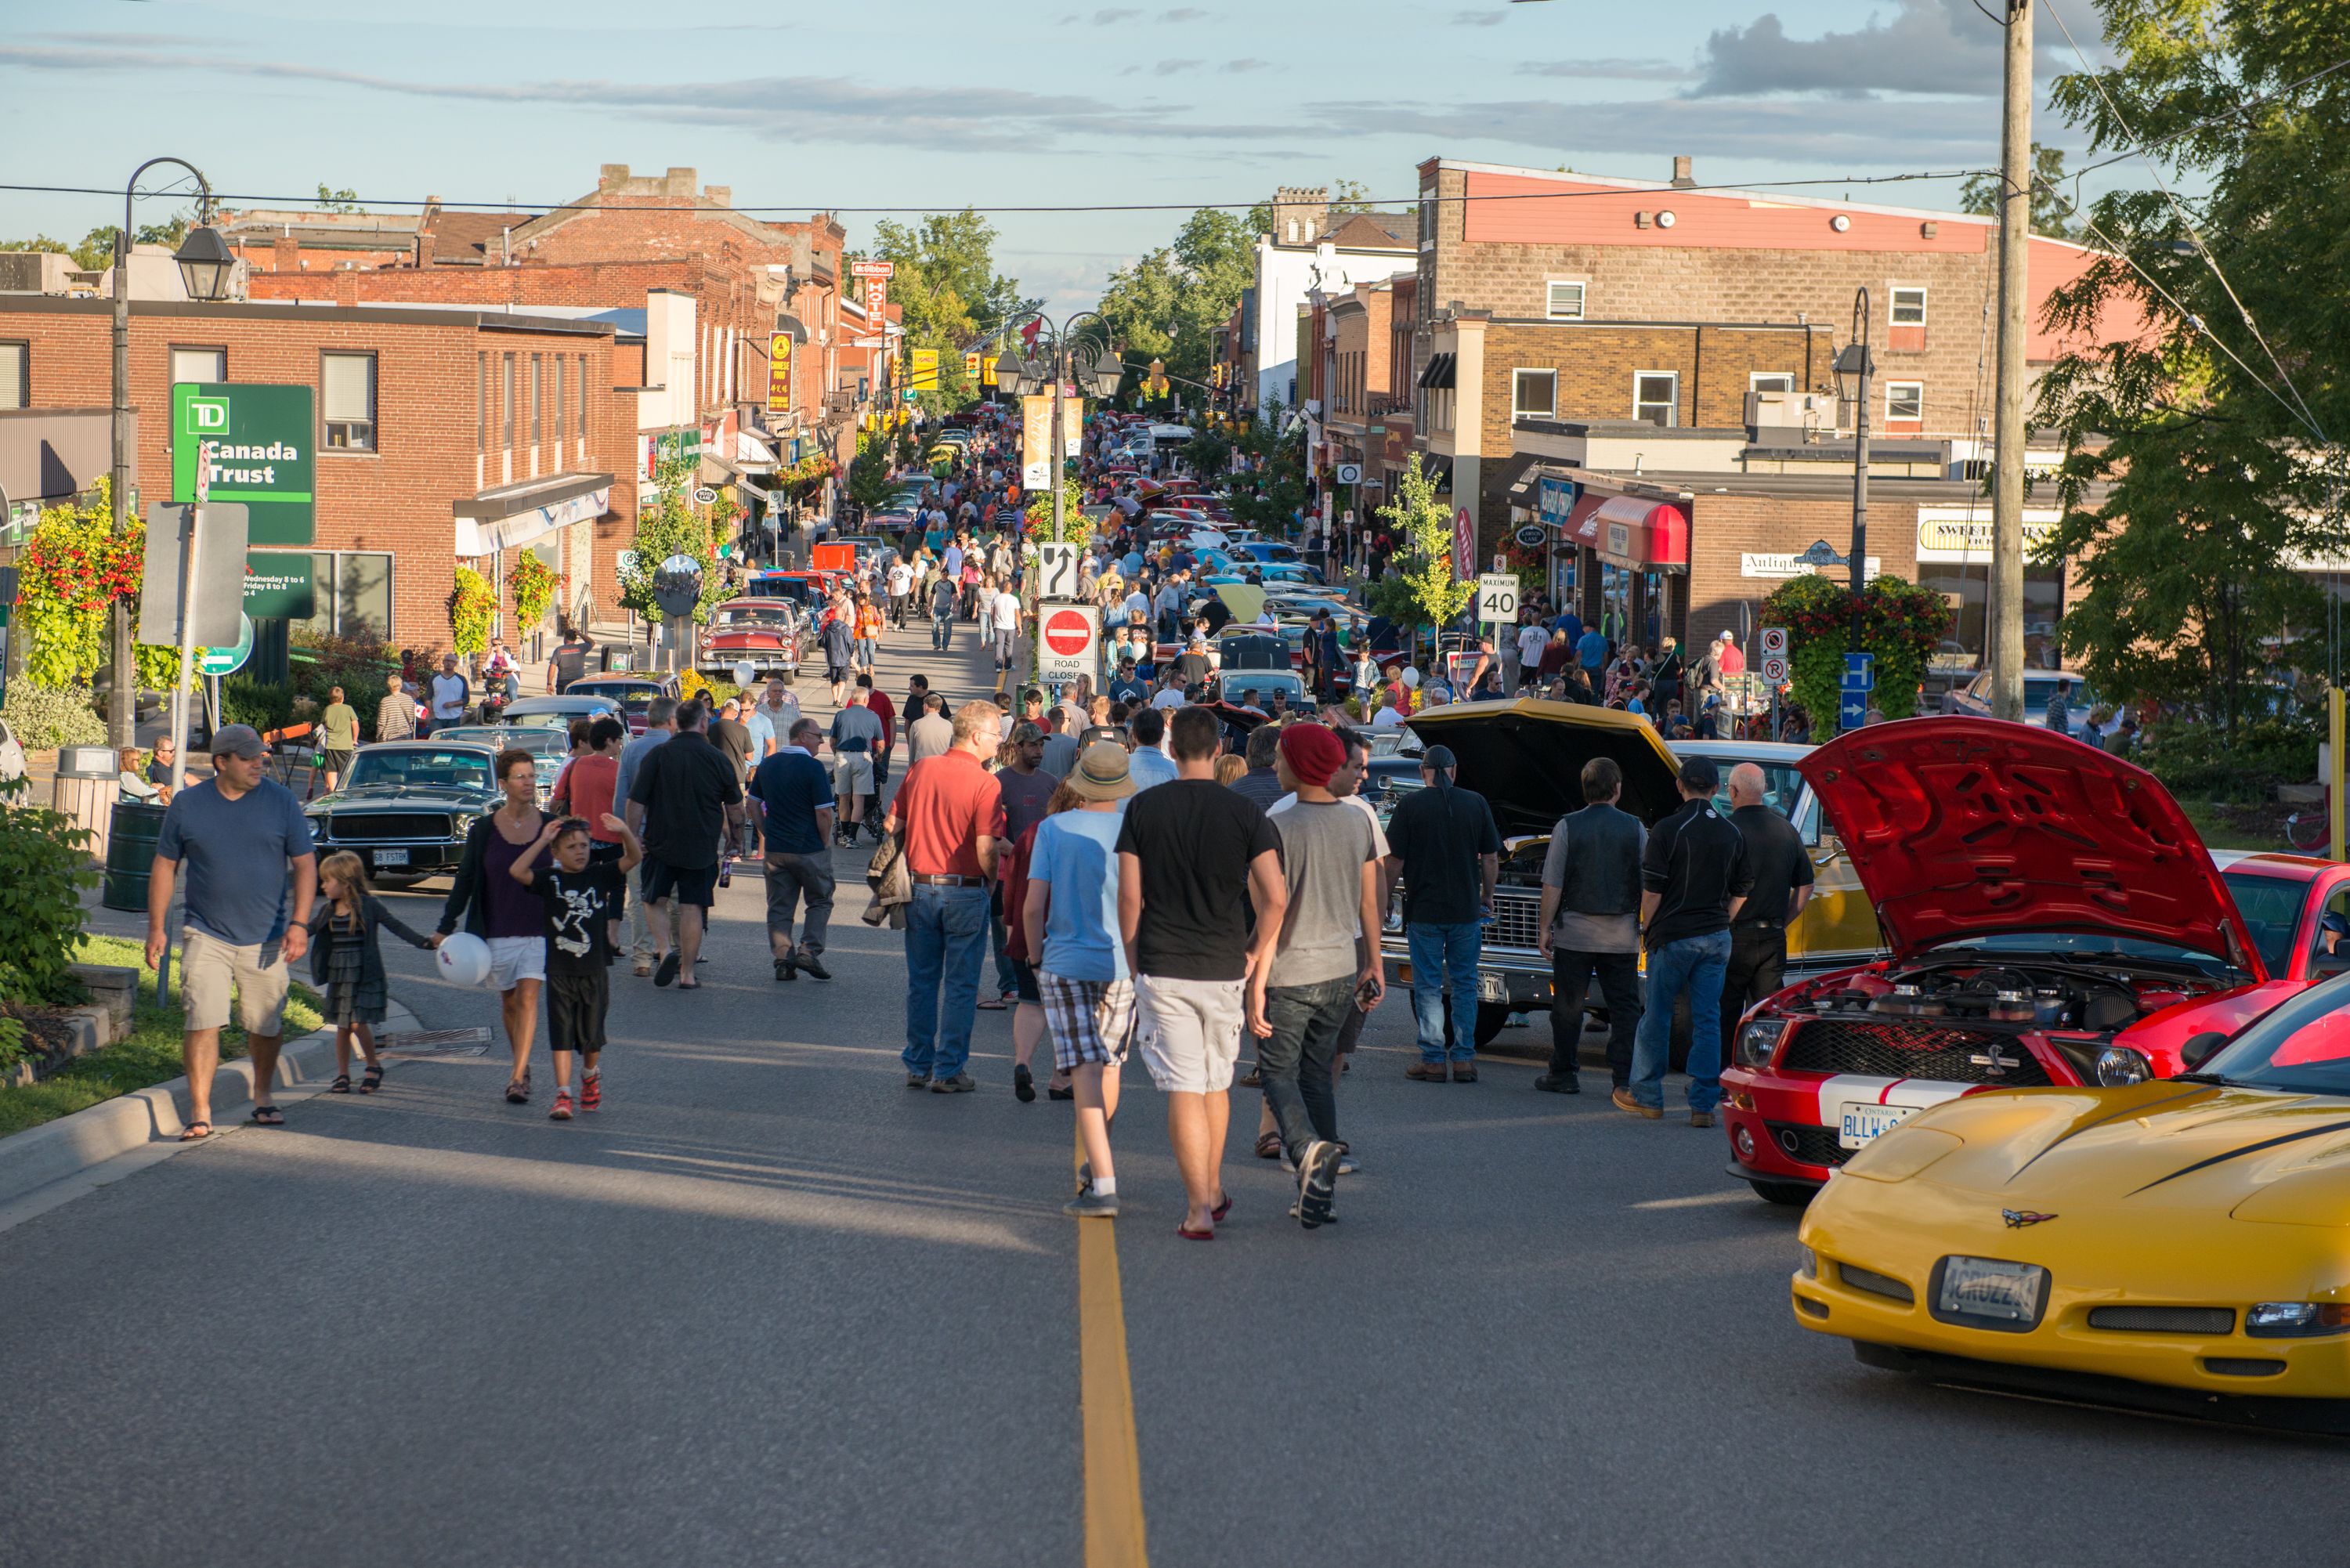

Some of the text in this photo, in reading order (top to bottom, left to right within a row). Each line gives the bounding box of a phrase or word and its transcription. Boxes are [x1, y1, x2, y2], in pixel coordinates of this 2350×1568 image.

[855, 265, 890, 273] McGibbon
[868, 282, 884, 331] HOTEL
[770, 360, 790, 370] CHINESE
[773, 370, 786, 380] FOOD
[191, 403, 225, 427] TD
[205, 441, 298, 461] Canada
[208, 464, 275, 484] Trust
[1936, 525, 1994, 537] SWEET
[1746, 555, 1806, 571] Antiqu
[1803, 555, 1828, 564] JAMES
[244, 582, 265, 591] Friday
[1483, 578, 1516, 587] MAXIMUM
[1483, 593, 1514, 613] 40
[1054, 659, 1080, 668] ROAD
[1842, 659, 1867, 685] H
[1843, 1115, 1880, 1138] BLLW
